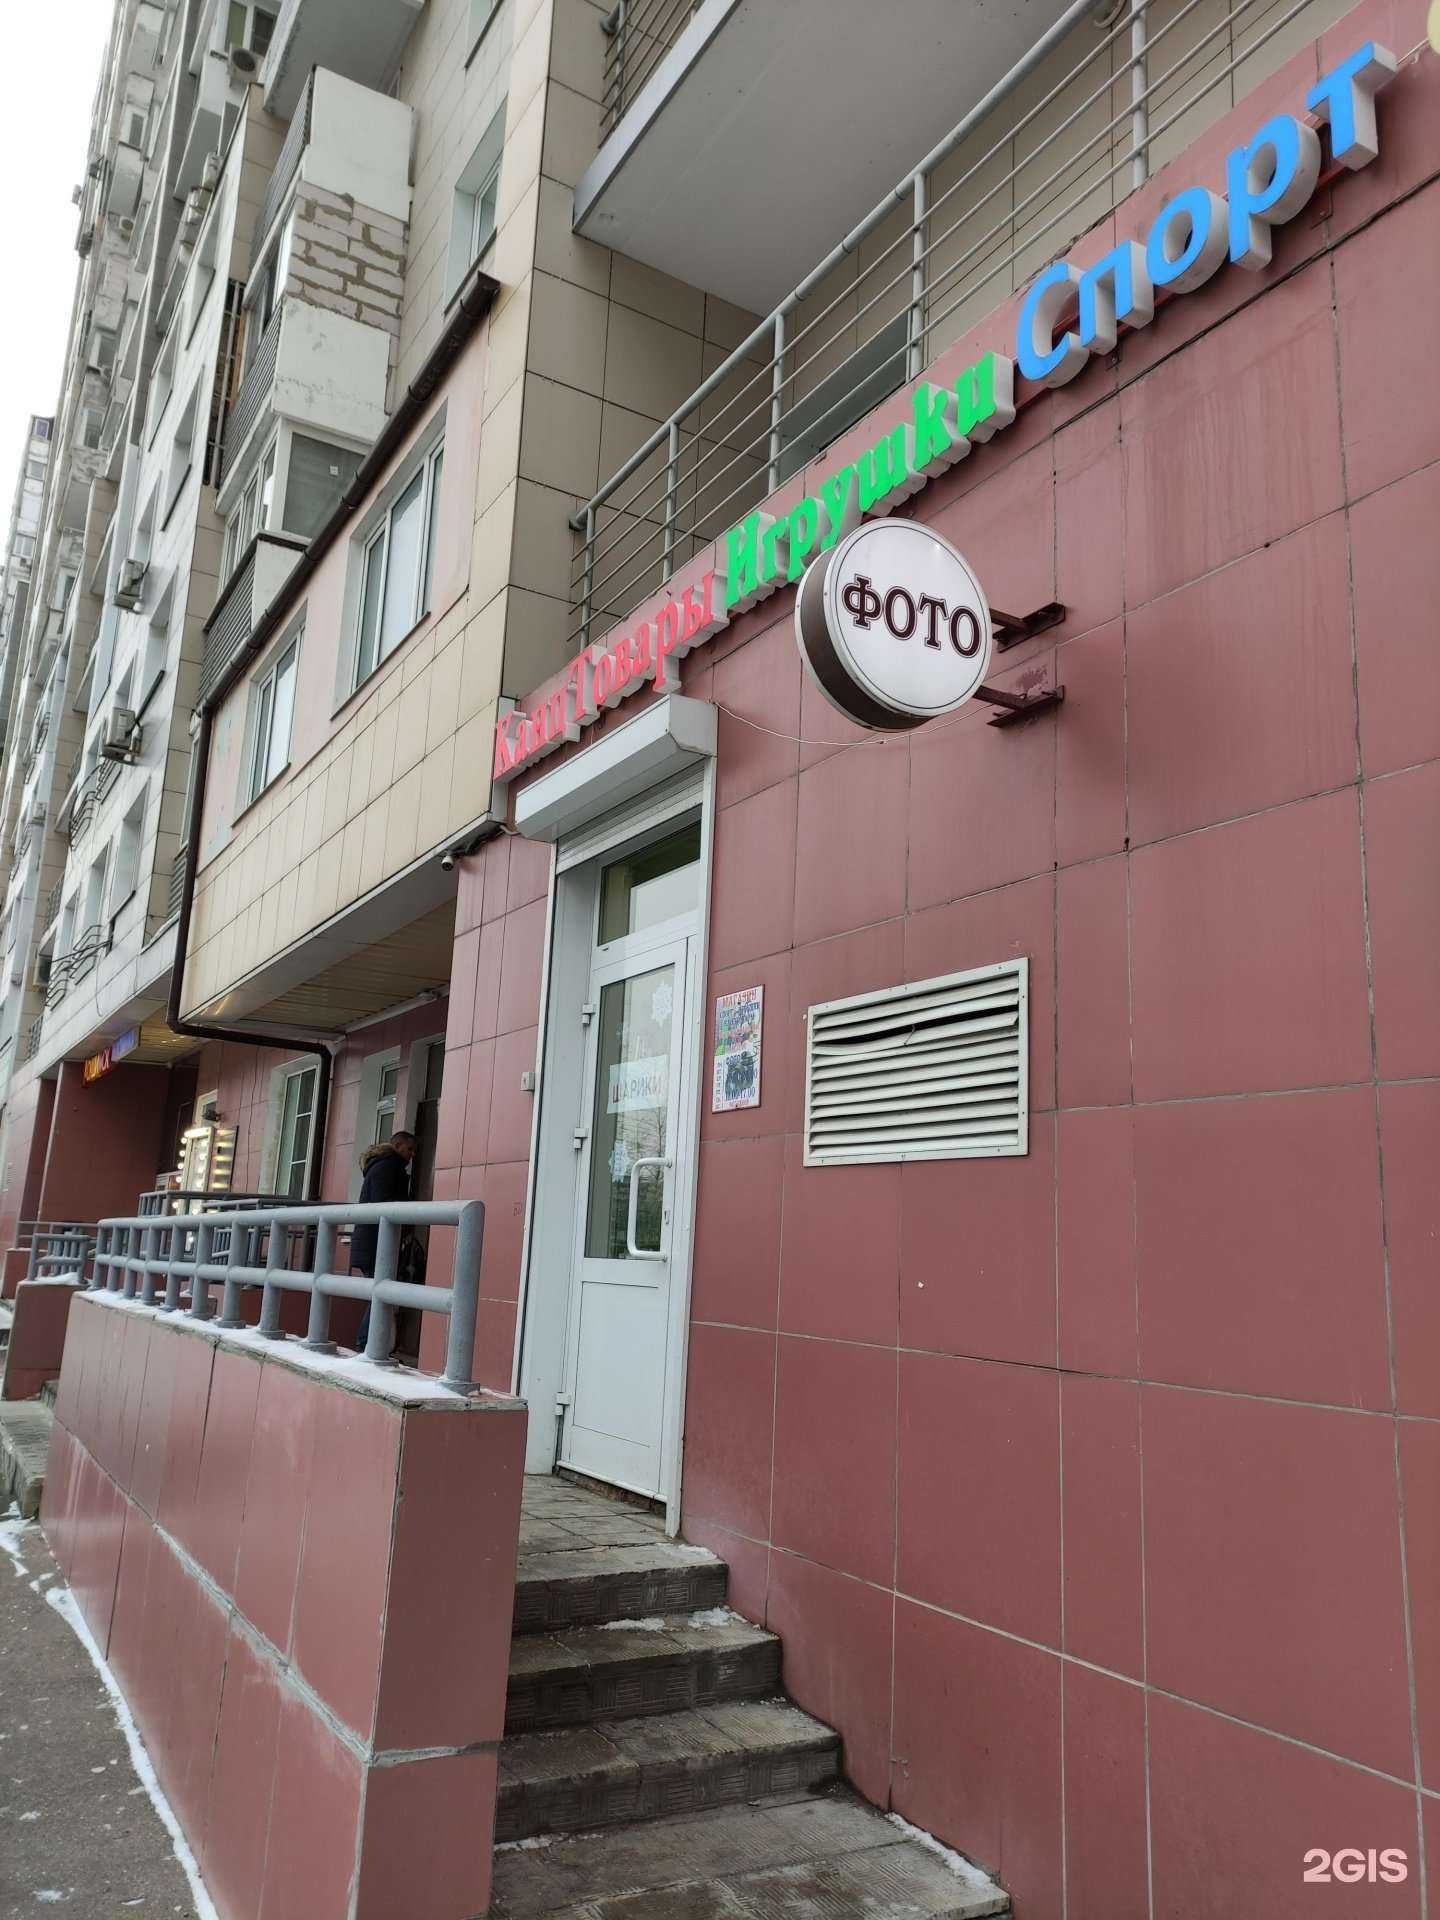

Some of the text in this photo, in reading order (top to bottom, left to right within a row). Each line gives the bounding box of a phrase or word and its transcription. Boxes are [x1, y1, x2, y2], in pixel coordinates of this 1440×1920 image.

[493, 40, 1376, 779] КанцТовары Игрушки Спорт
[842, 573, 981, 658] ФОТО
